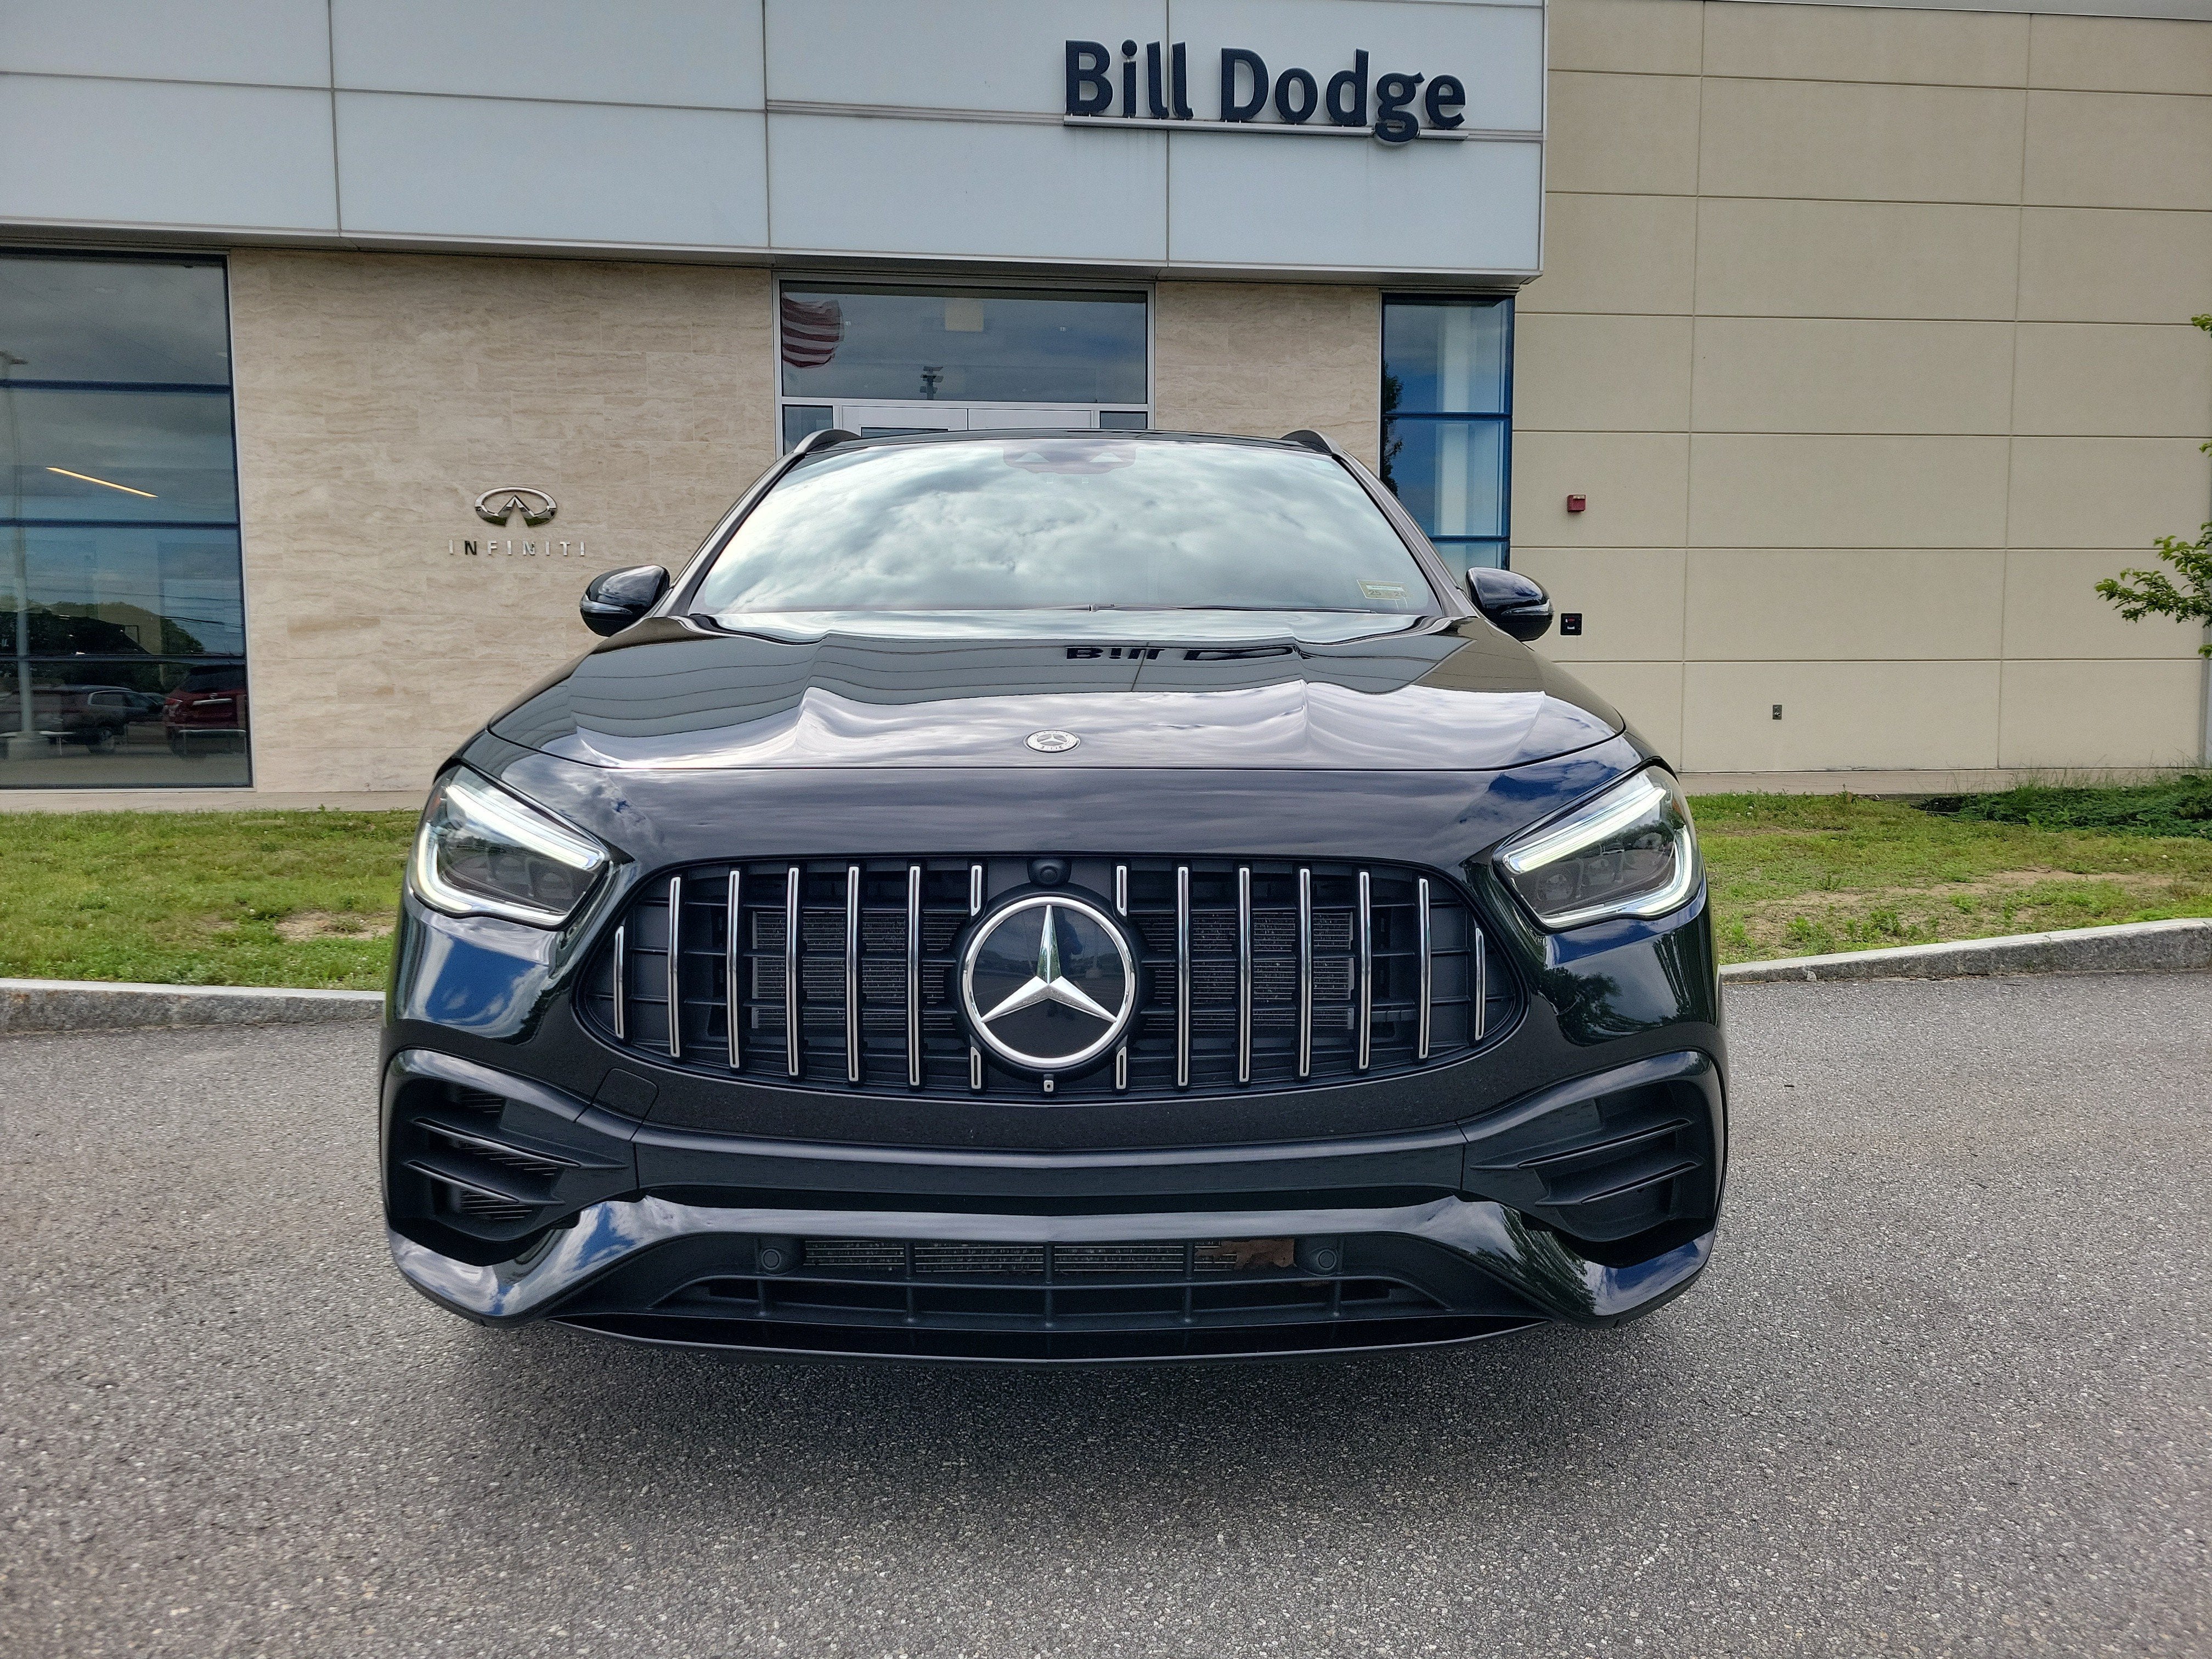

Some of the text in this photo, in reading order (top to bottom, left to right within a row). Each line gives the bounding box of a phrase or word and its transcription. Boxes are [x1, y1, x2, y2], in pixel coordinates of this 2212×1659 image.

[1065, 39, 1466, 144] Bill Dodge
[449, 539, 585, 556] INFINITI
